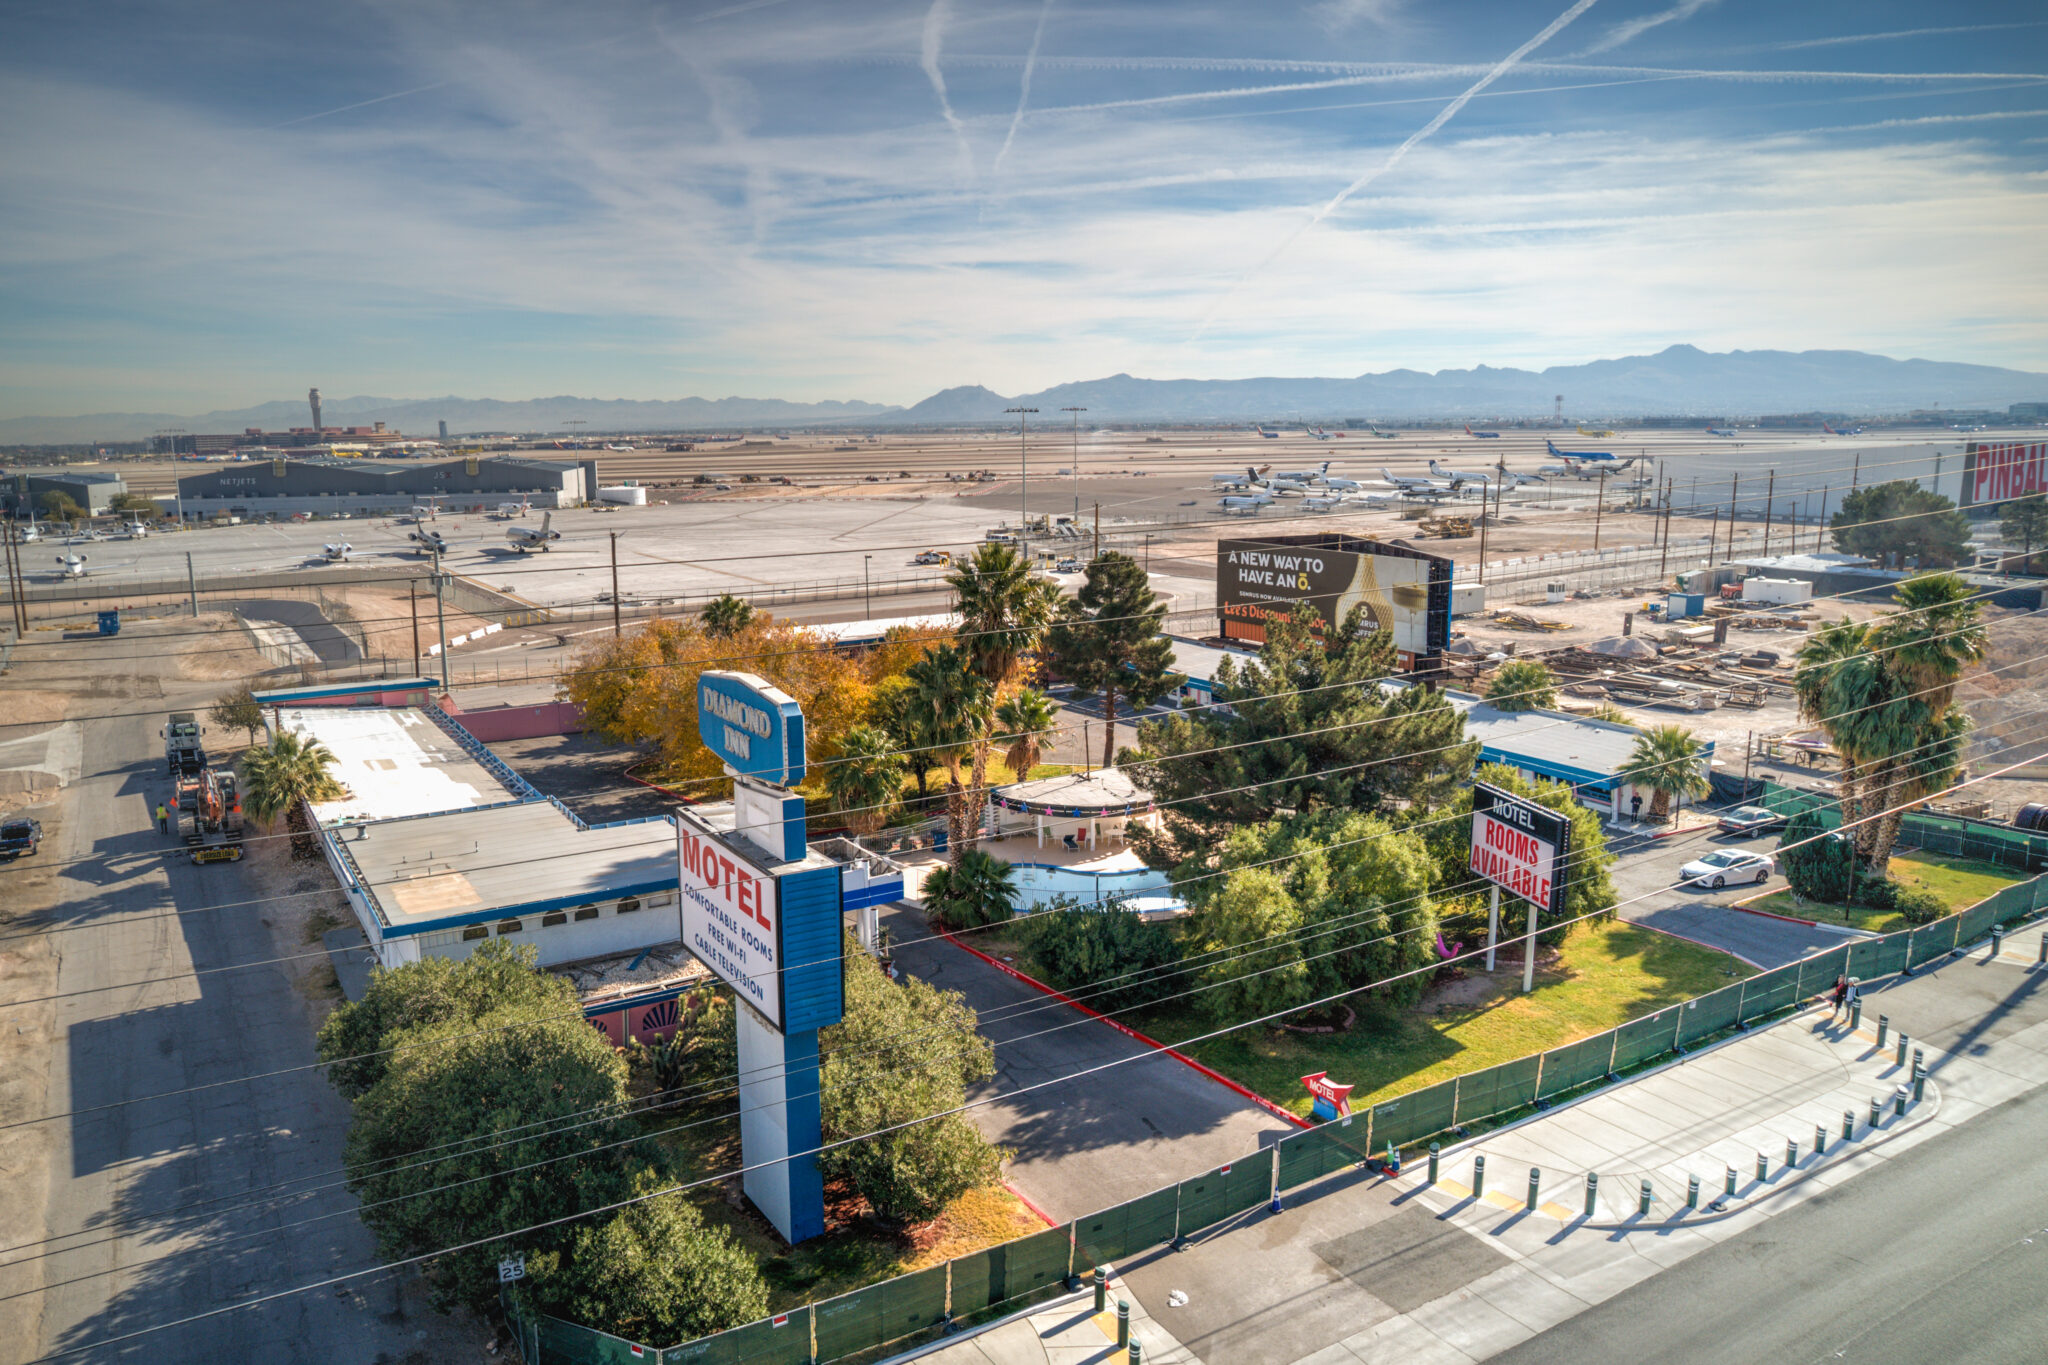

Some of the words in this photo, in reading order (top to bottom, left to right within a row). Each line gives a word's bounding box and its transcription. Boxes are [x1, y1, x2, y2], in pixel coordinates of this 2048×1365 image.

[220, 477, 257, 487] NETJETS
[1228, 551, 1238, 564] A
[1240, 551, 1270, 568] NEW
[1273, 554, 1302, 571] WAY
[1303, 558, 1324, 574] TO
[1239, 568, 1274, 586] HAVE
[1276, 573, 1296, 589] AN
[703, 686, 771, 739] DIAMOND
[724, 725, 750, 760] INN
[1493, 797, 1535, 830] MOTEL
[1486, 818, 1539, 867] ROOMS
[683, 828, 771, 932] MOTEL
[1471, 844, 1550, 908] AVAILABLE
[684, 883, 738, 934] COMFORTABLE
[741, 926, 773, 962] ROOMS
[708, 922, 725, 946] FREE
[726, 937, 747, 964] WI-FI
[695, 932, 717, 960] CABLE
[718, 951, 764, 1001] TELEVISION
[1309, 1079, 1337, 1102] MOTEL
[502, 1265, 523, 1279] 25
